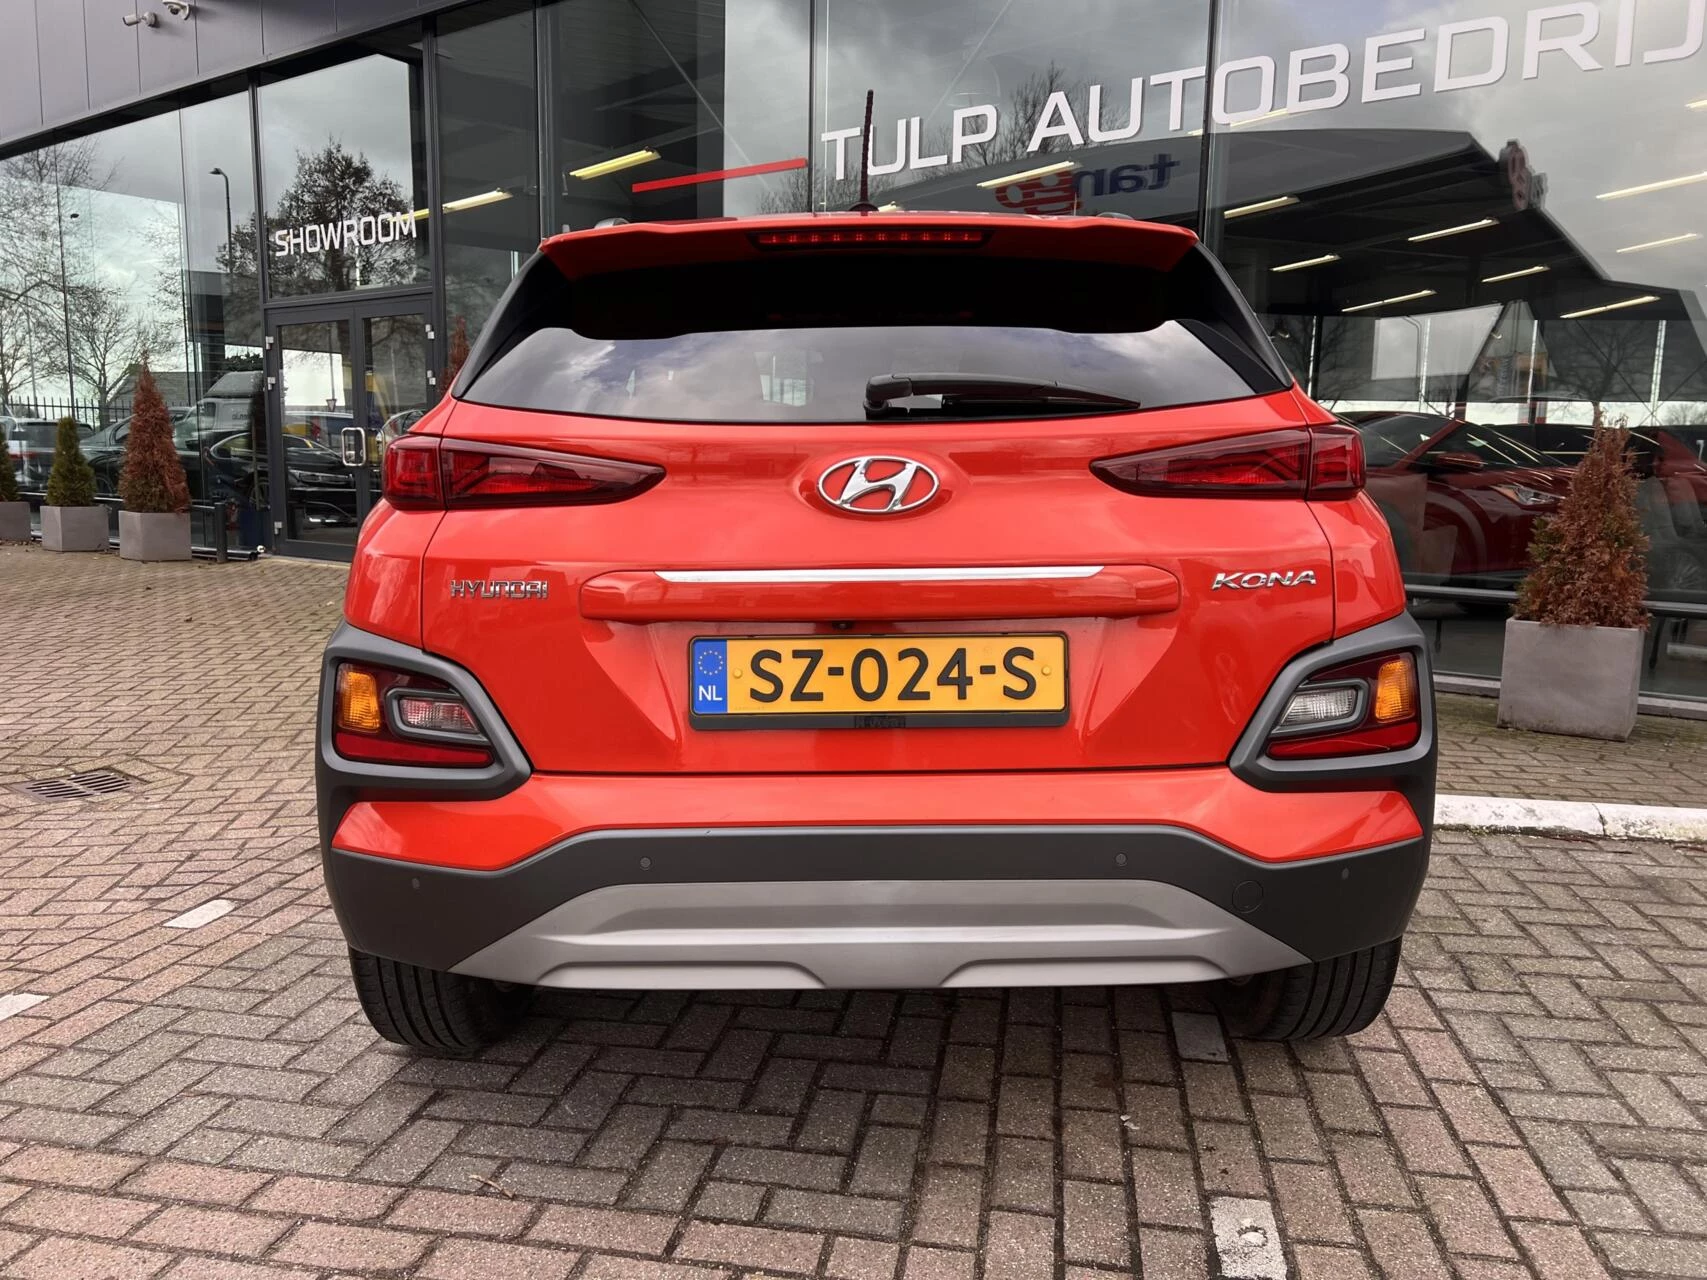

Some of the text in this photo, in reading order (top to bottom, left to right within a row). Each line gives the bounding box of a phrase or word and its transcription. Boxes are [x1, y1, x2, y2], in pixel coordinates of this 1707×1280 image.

[821, 0, 1706, 181] TULP AUTOBEDRIJ
[275, 209, 417, 257] SHOWROOM
[450, 580, 548, 599] HYUNDAI
[1211, 570, 1317, 590] KONA
[749, 646, 1036, 703] SZ-024-S
[698, 684, 723, 701] NL
